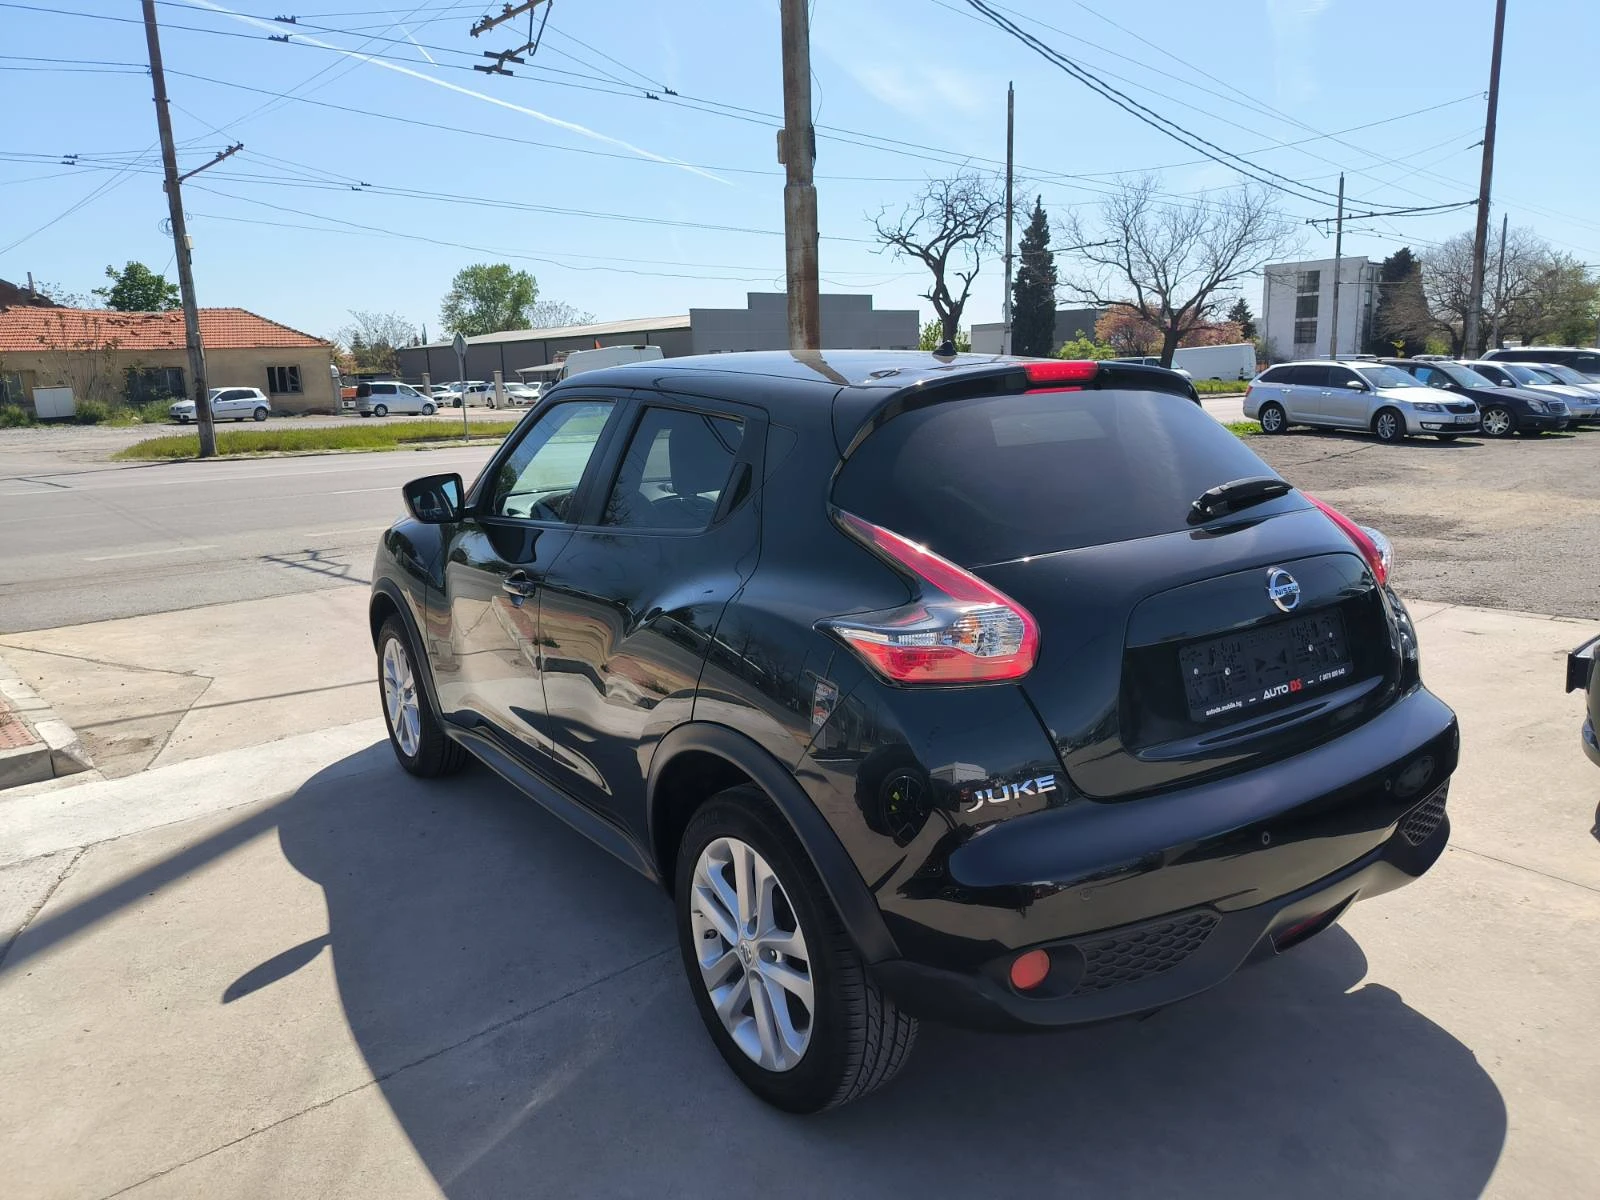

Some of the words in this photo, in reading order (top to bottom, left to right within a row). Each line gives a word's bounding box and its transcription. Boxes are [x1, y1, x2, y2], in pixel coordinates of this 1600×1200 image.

[1263, 684, 1289, 700] AUTO
[1290, 678, 1303, 692] DS
[966, 774, 1057, 813] JUKE
